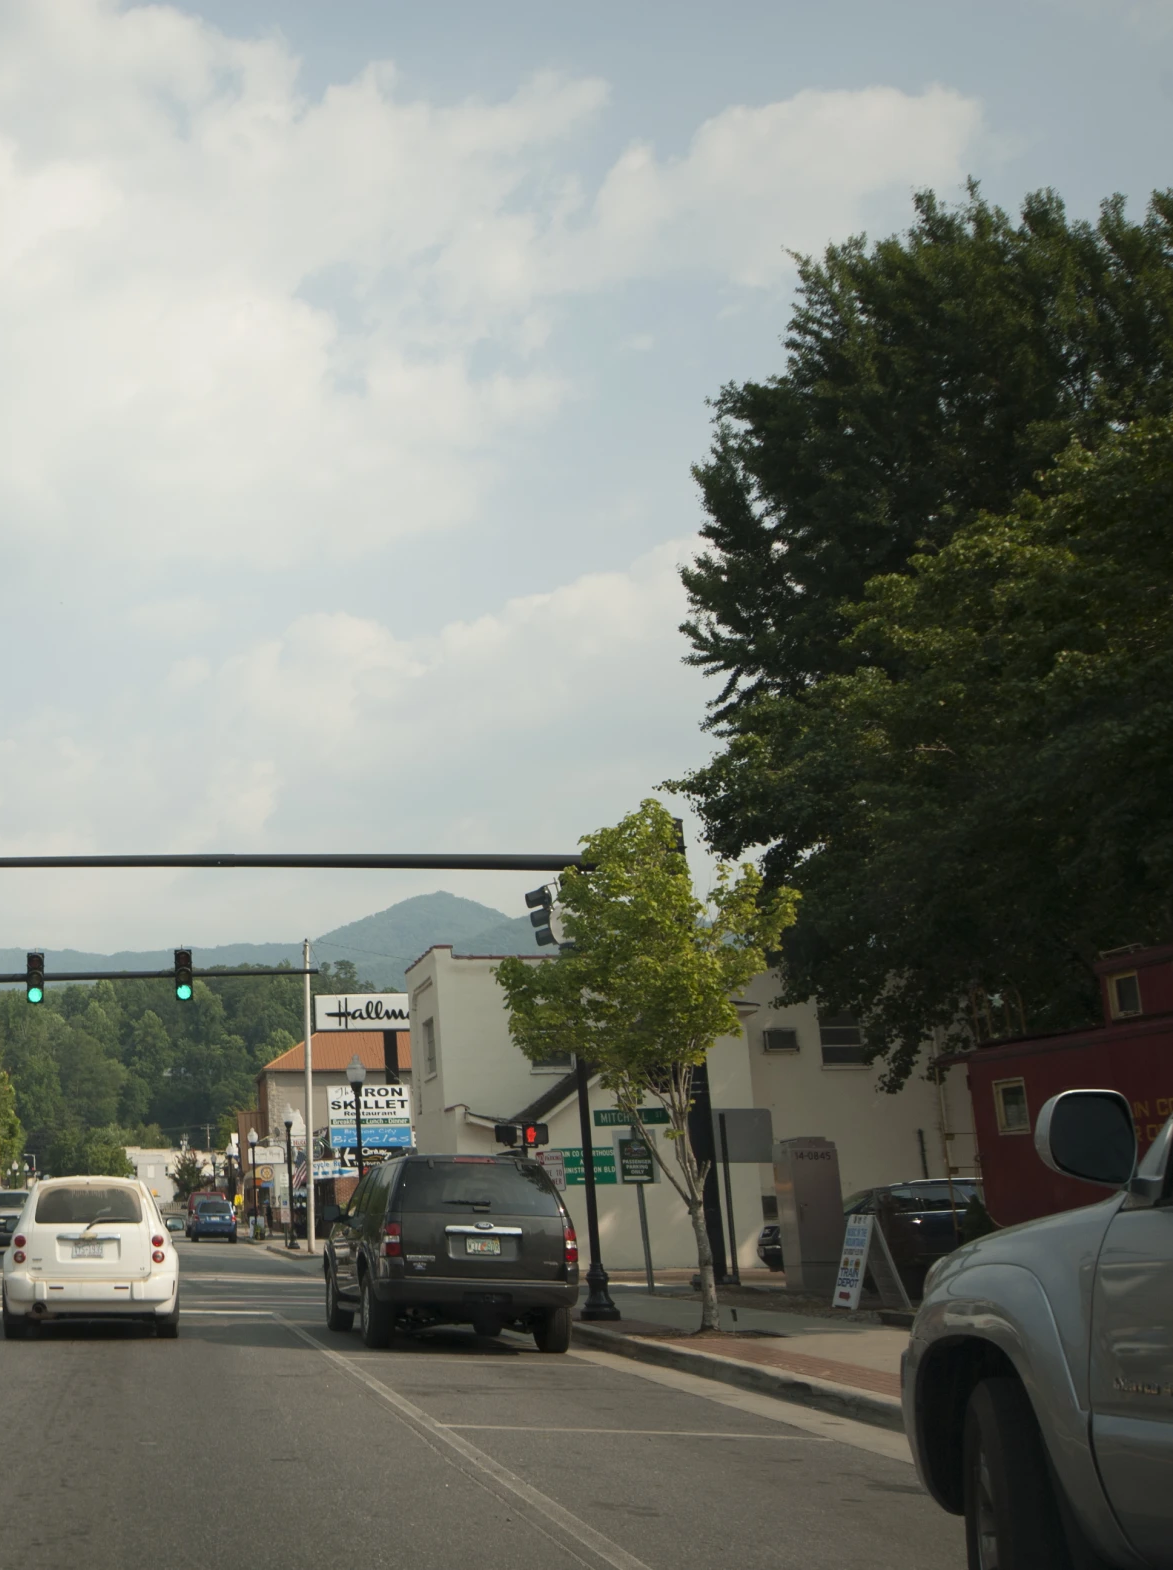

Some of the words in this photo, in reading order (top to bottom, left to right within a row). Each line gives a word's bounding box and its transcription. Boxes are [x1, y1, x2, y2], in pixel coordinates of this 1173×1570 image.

[600, 1112, 648, 1124] MITCHL
[332, 1134, 410, 1146] Bicycles
[795, 1151, 831, 1160] 14-0845
[840, 1267, 859, 1278] TRAIN
[837, 1278, 859, 1288] DEPOT
